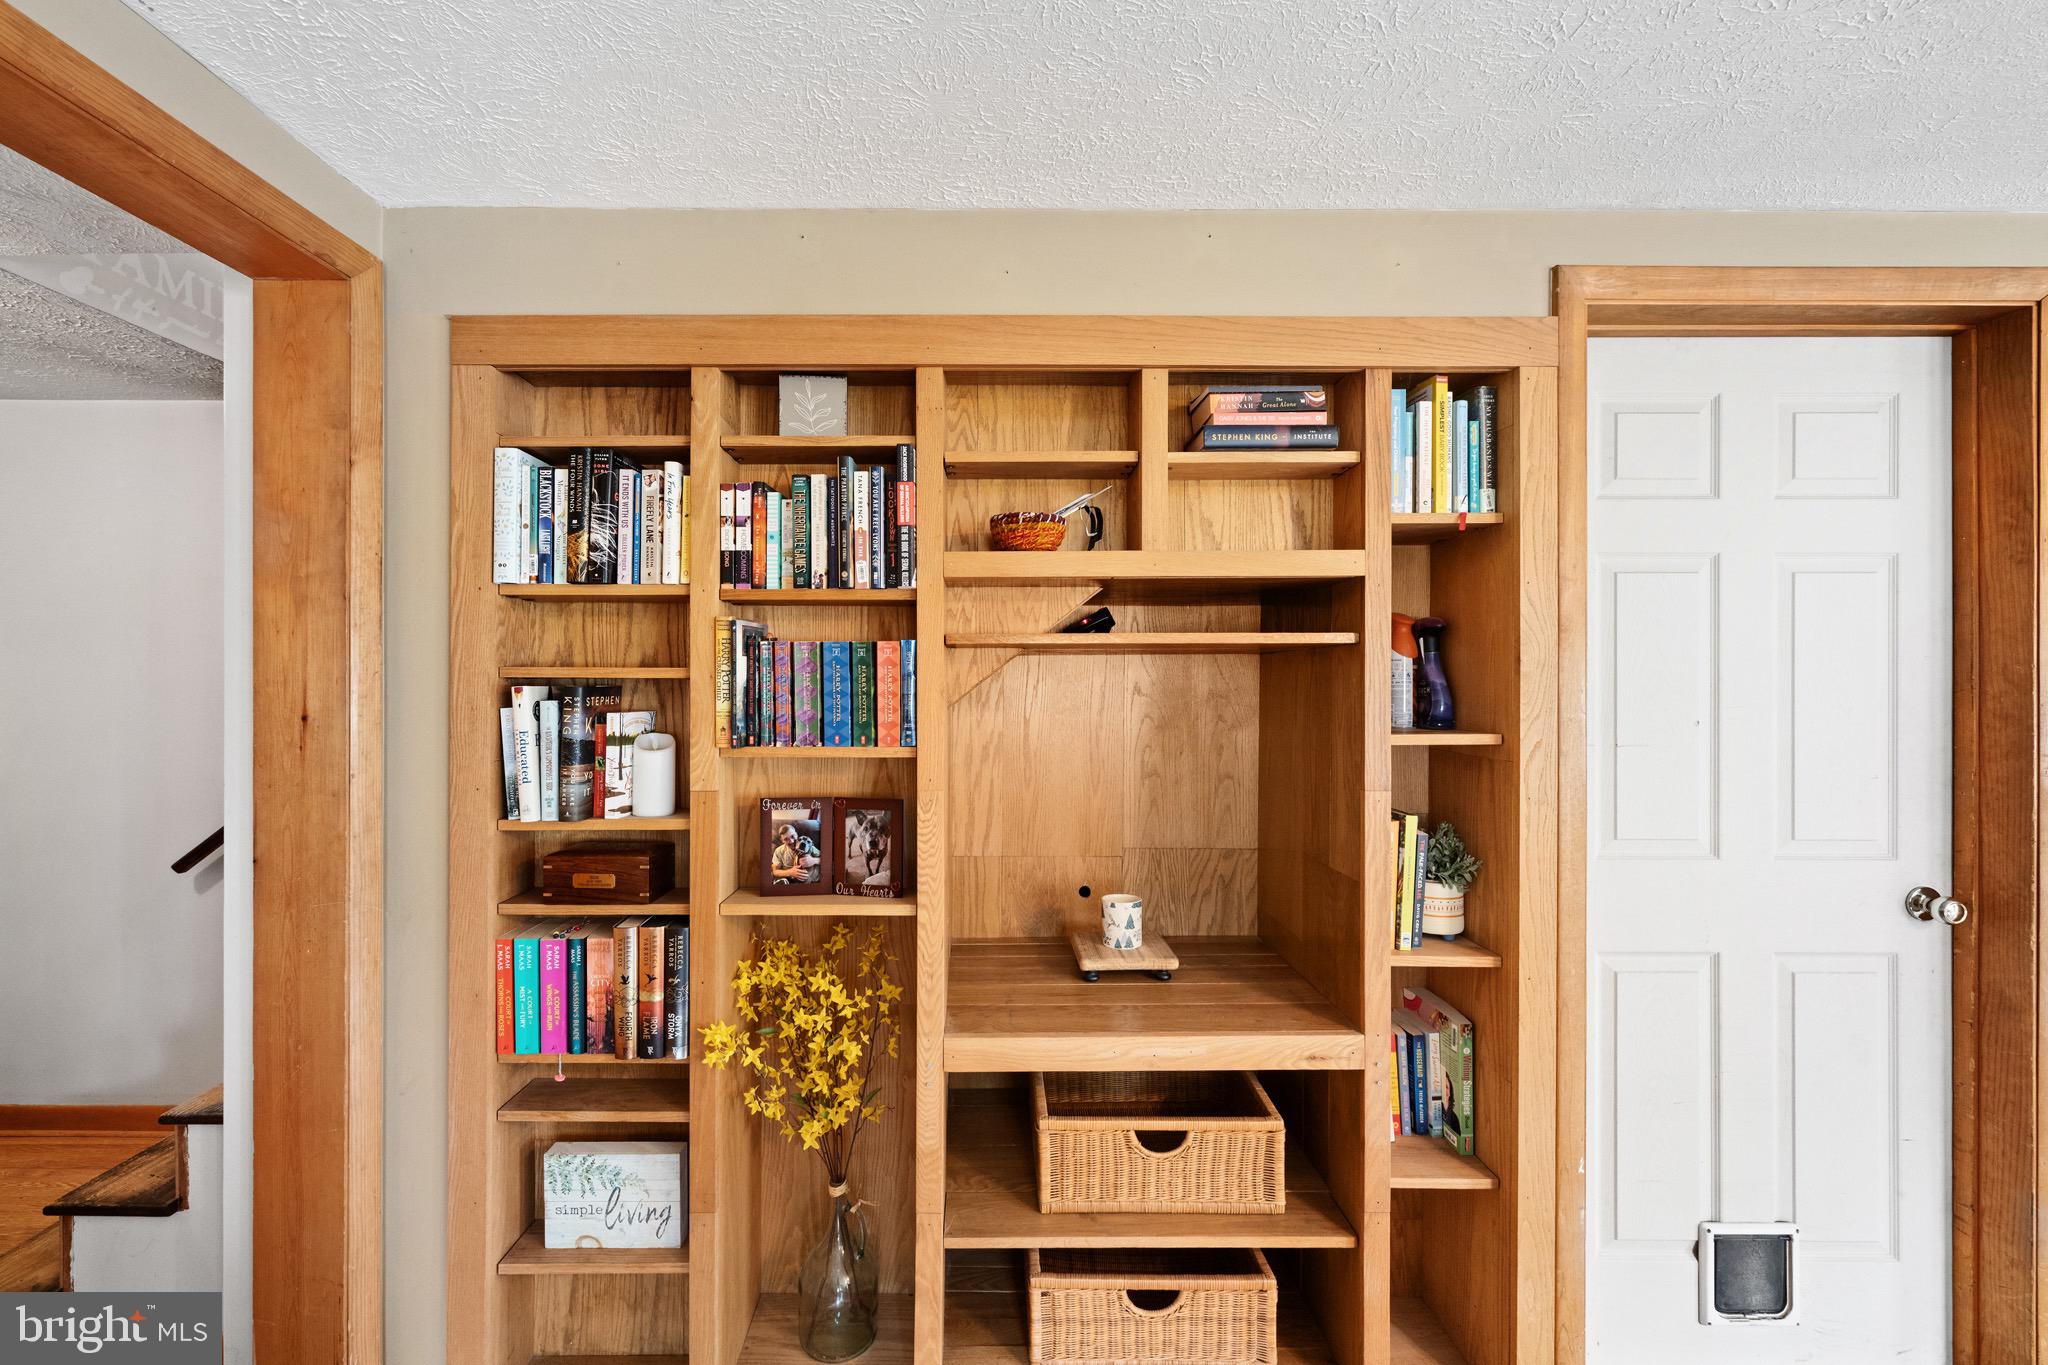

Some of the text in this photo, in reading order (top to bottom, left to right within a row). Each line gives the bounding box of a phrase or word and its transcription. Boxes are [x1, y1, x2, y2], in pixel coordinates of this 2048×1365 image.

[84, 254, 224, 322] AMI
[1211, 433, 1278, 441] STEPHEN KING
[540, 469, 552, 519] BLACKSTOCK
[621, 483, 629, 500] ENDS
[667, 480, 676, 495] Five
[794, 489, 806, 504] THE
[621, 501, 629, 518] WITH
[646, 495, 654, 544] FIREFLY LANE
[665, 497, 674, 520] Years
[621, 519, 629, 529] US
[794, 505, 806, 547] INHERITANCE
[794, 548, 806, 573] GAMES
[721, 637, 731, 704] HARRY POTTER
[585, 695, 620, 707] STEPHEN
[562, 696, 572, 735] KING
[573, 696, 581, 735] STEPHEN
[519, 730, 532, 784] Educated
[583, 772, 594, 780] YO
[762, 798, 822, 811] Forever in
[835, 882, 895, 898] Our Hearts
[590, 979, 610, 987] CITY
[572, 981, 580, 1018] ASSASSIN'S
[572, 1019, 580, 1040] BLADE
[625, 1012, 633, 1041] FOURTH
[642, 1012, 650, 1040] FLAME
[650, 1016, 658, 1035] IRON
[667, 1013, 675, 1040] STORM
[674, 1015, 682, 1037] ONYX
[1462, 1055, 1472, 1081] Writing
[1462, 1080, 1472, 1115] Strategies
[555, 1186, 672, 1240] simple living
